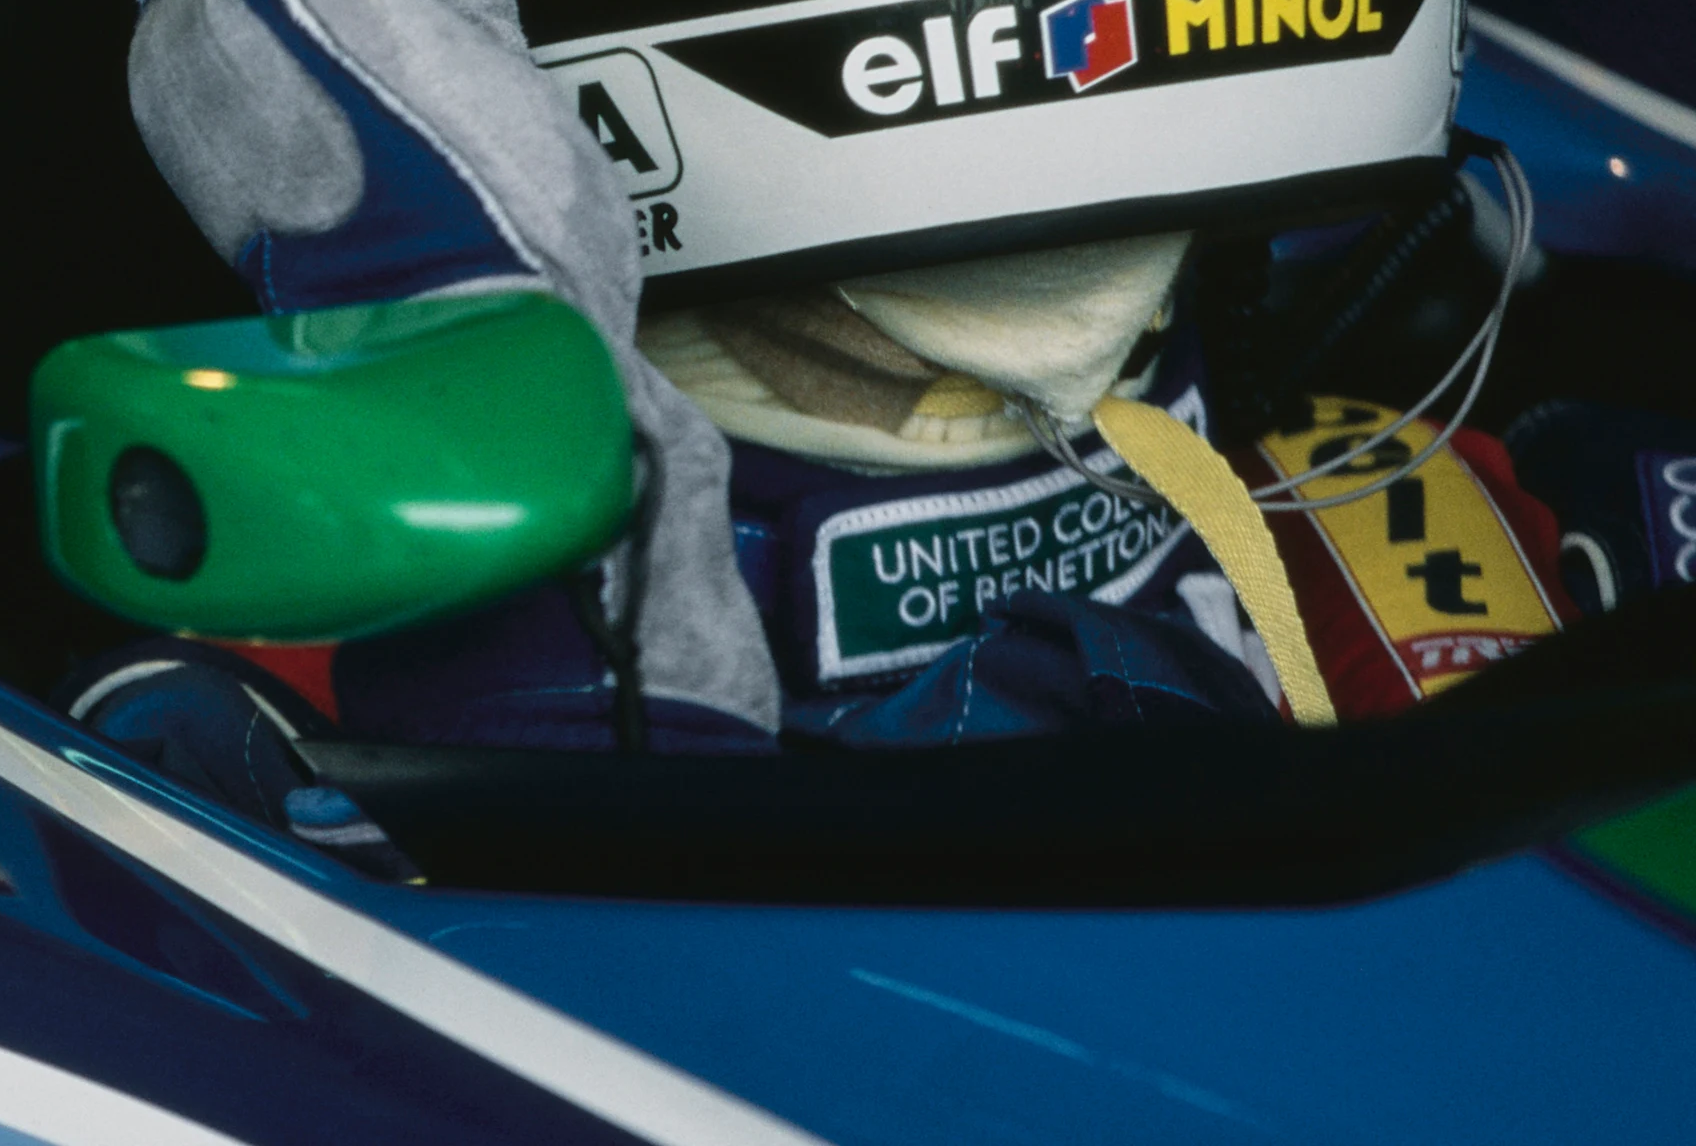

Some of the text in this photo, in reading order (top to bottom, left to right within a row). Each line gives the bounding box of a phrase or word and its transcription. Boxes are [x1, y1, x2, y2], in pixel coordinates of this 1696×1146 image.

[842, 6, 1020, 116] elf
[872, 516, 1041, 584] UNITED
[898, 581, 959, 628] OF
